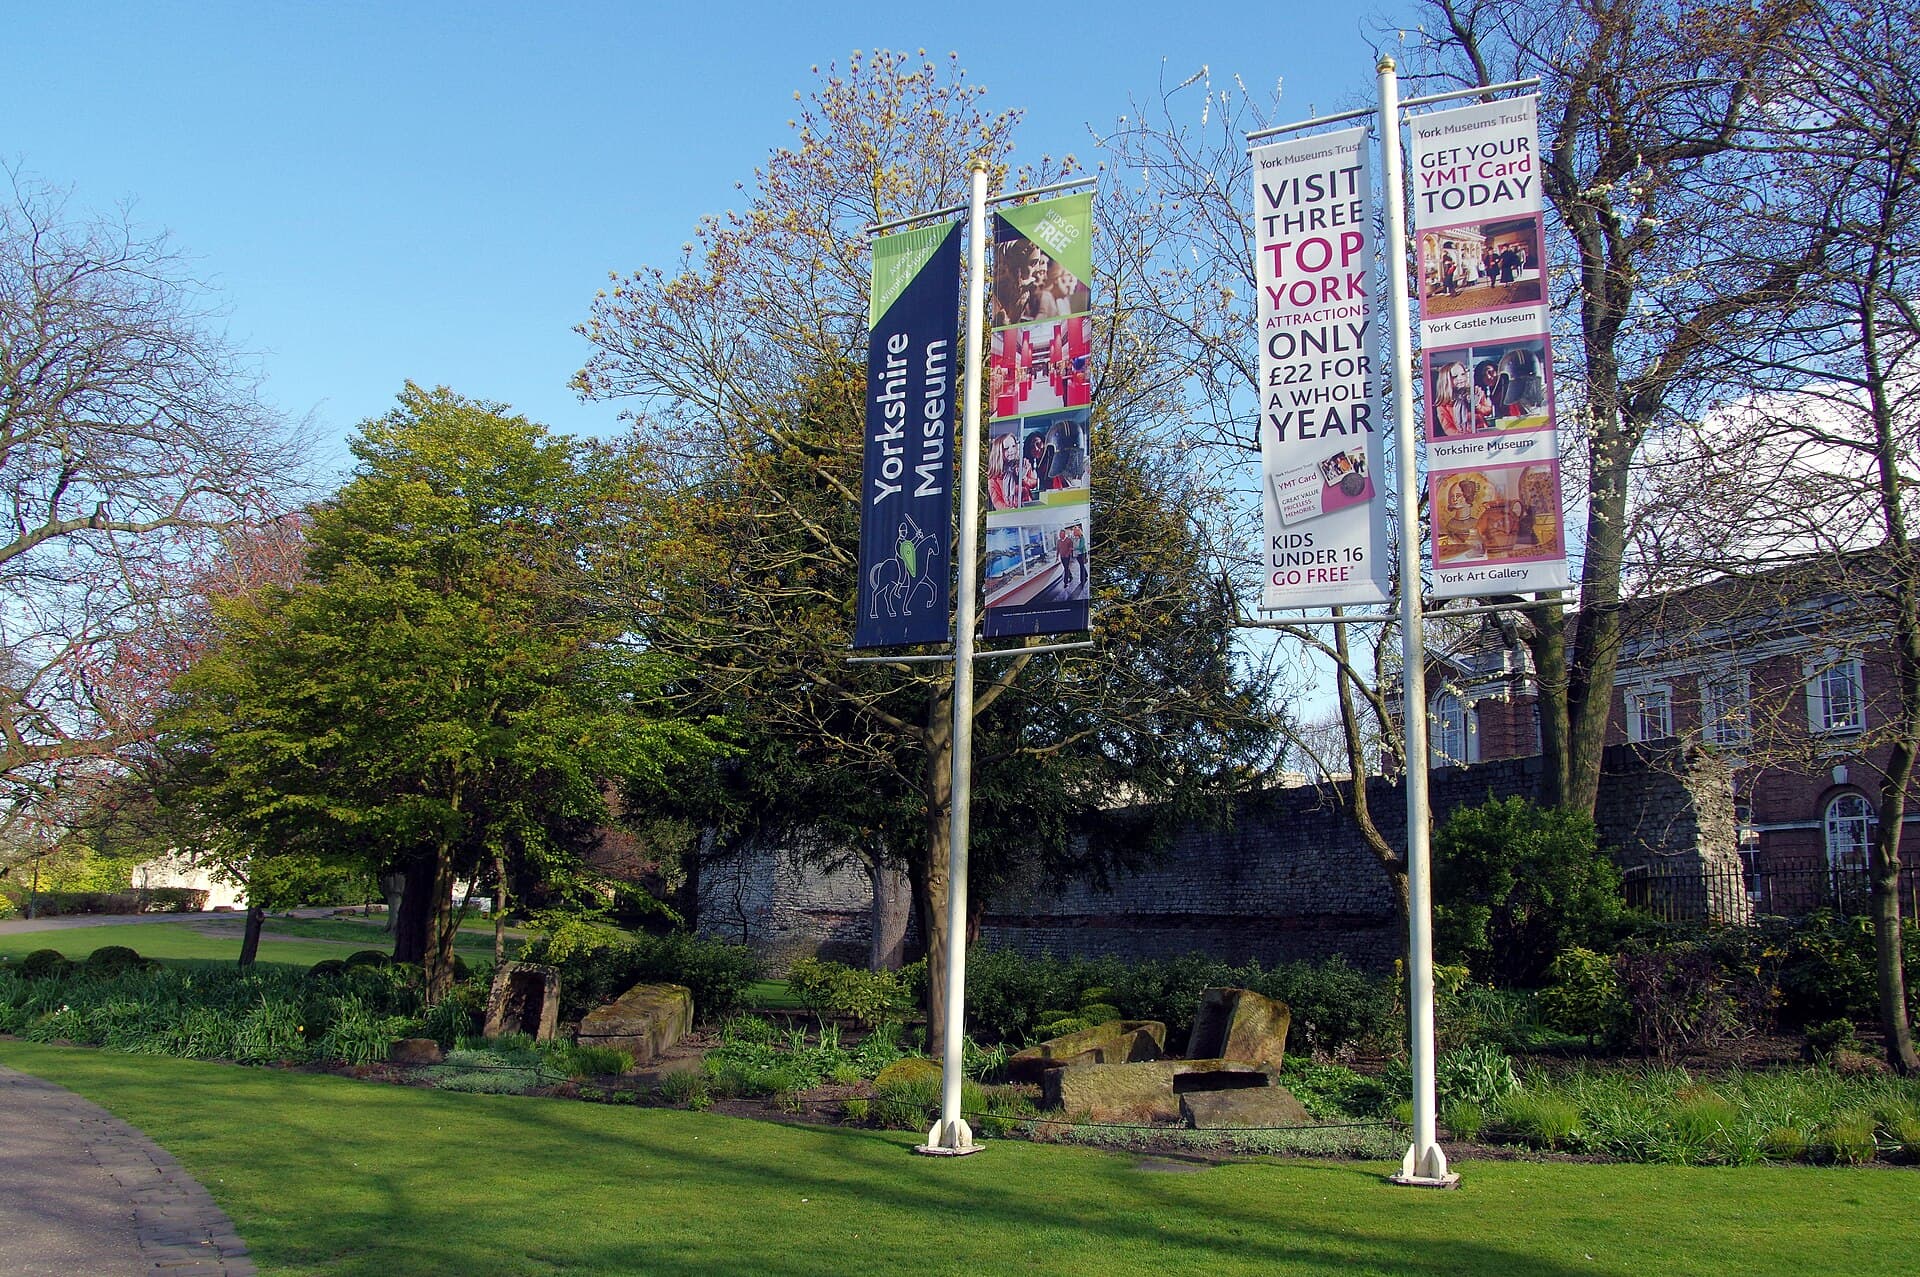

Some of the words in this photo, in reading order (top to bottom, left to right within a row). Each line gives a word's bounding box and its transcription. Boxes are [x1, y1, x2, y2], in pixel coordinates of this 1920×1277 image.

[1418, 127, 1442, 139] York
[1444, 119, 1497, 135] Museums
[1499, 113, 1528, 125] Trust
[1260, 156, 1282, 169] York
[1284, 148, 1333, 164] Museums
[1335, 142, 1361, 155] Trust
[1420, 148, 1461, 168] GET
[1466, 137, 1530, 160] YOUR
[1421, 164, 1471, 188] YMT
[1478, 153, 1531, 178] Card
[1262, 165, 1363, 209] VISIT
[1421, 175, 1532, 213] TODAY
[1046, 208, 1067, 228] KIDS
[1065, 224, 1080, 238] GO
[1262, 200, 1364, 237] THREE
[1263, 230, 1365, 278] TOP
[1265, 270, 1369, 311] YORK
[1265, 303, 1371, 329] ATTRACTIONS
[1427, 320, 1451, 334] York
[1453, 316, 1487, 330] Castle
[1489, 311, 1536, 326] Museum
[1268, 320, 1370, 361] ONLY
[1268, 362, 1313, 387] £22
[1322, 356, 1372, 381] FOR
[1268, 393, 1283, 410] A
[1289, 381, 1374, 406] WHOLE
[874, 333, 910, 506] Yorkshire
[914, 339, 948, 498] Museum
[1268, 403, 1375, 443] YEAR
[1433, 442, 1484, 457] Yorkshire
[1487, 437, 1534, 451] Museum
[1278, 480, 1296, 491] YMT
[1298, 472, 1317, 484] Card
[1281, 494, 1301, 505] GREAT
[1301, 489, 1319, 498] VALUE
[1283, 499, 1312, 511] PRICELESS
[1285, 505, 1316, 518] MEMORIES
[1272, 533, 1314, 550] KIDS
[1272, 549, 1338, 568] UNDER
[1343, 547, 1363, 562] 16
[1272, 570, 1301, 586] GO
[1440, 571, 1463, 584] York
[1466, 570, 1485, 581] Art
[1487, 567, 1529, 582] Gallery
